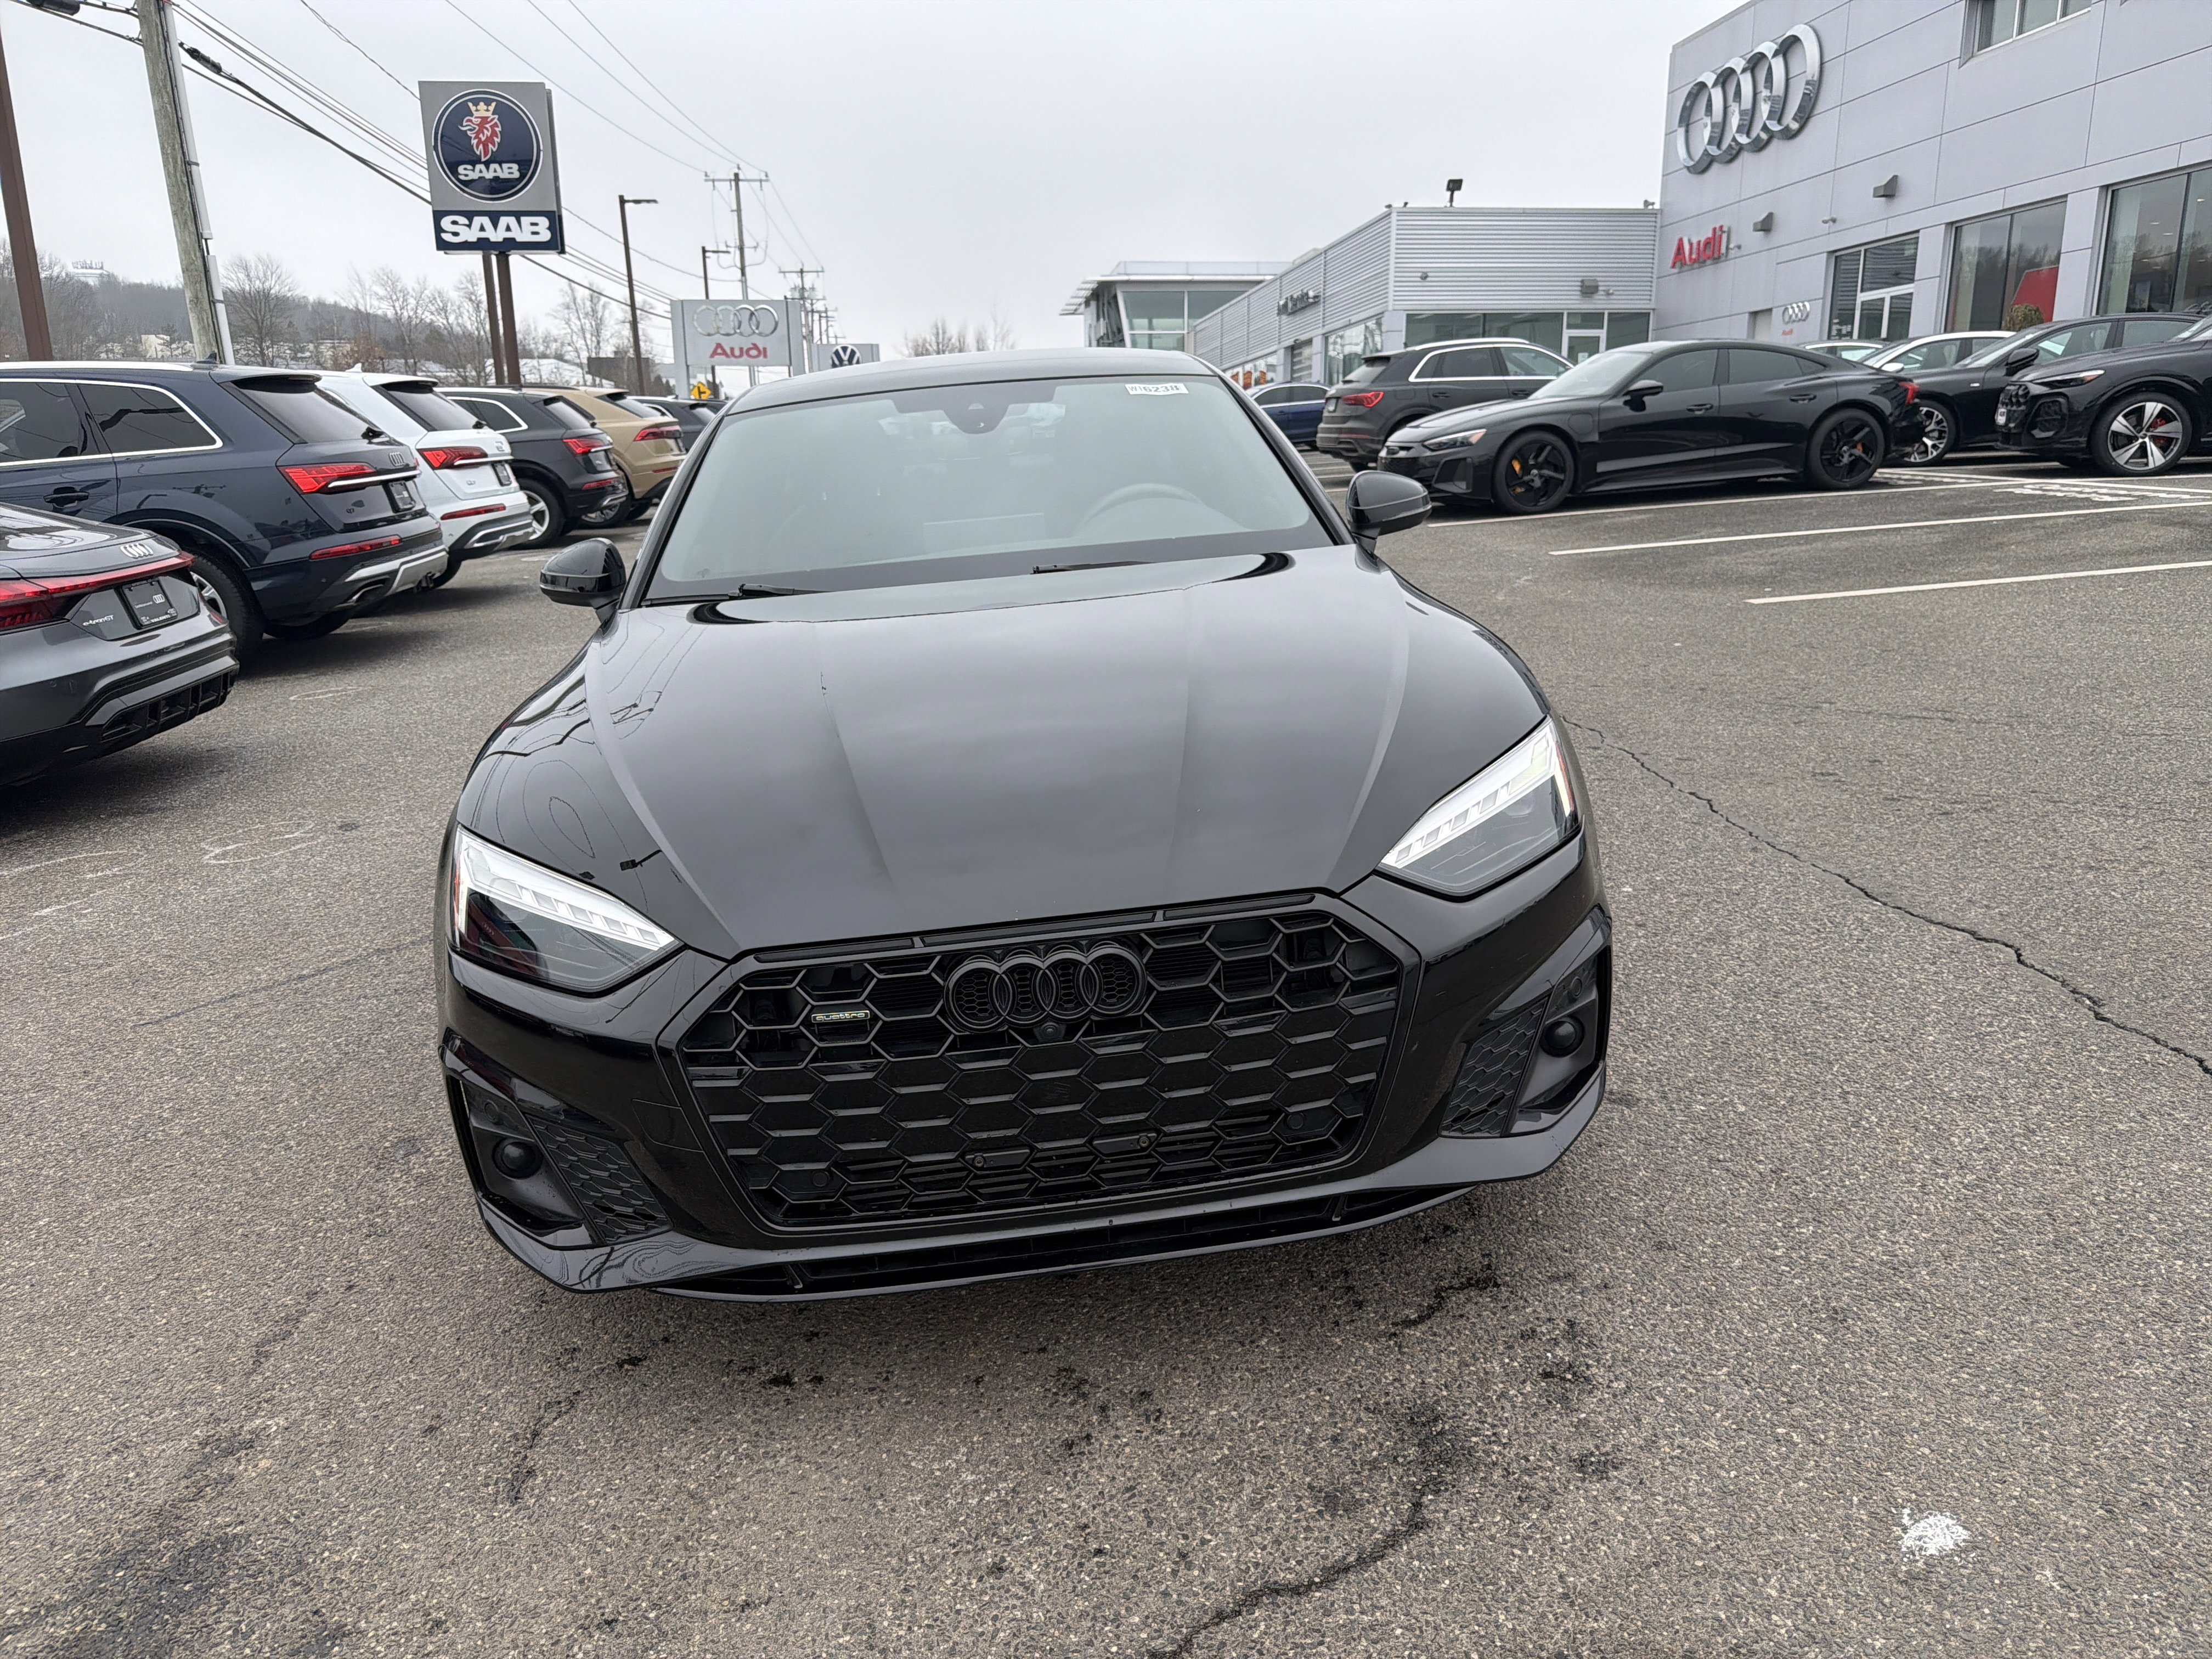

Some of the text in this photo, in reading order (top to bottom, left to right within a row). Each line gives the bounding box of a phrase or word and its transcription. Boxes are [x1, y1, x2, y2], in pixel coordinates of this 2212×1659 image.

[458, 163, 520, 180] SAAB
[440, 215, 551, 243] SAAB
[1671, 225, 1724, 269] Audi
[710, 342, 768, 359] Audi
[816, 1013, 865, 1021] quattro
